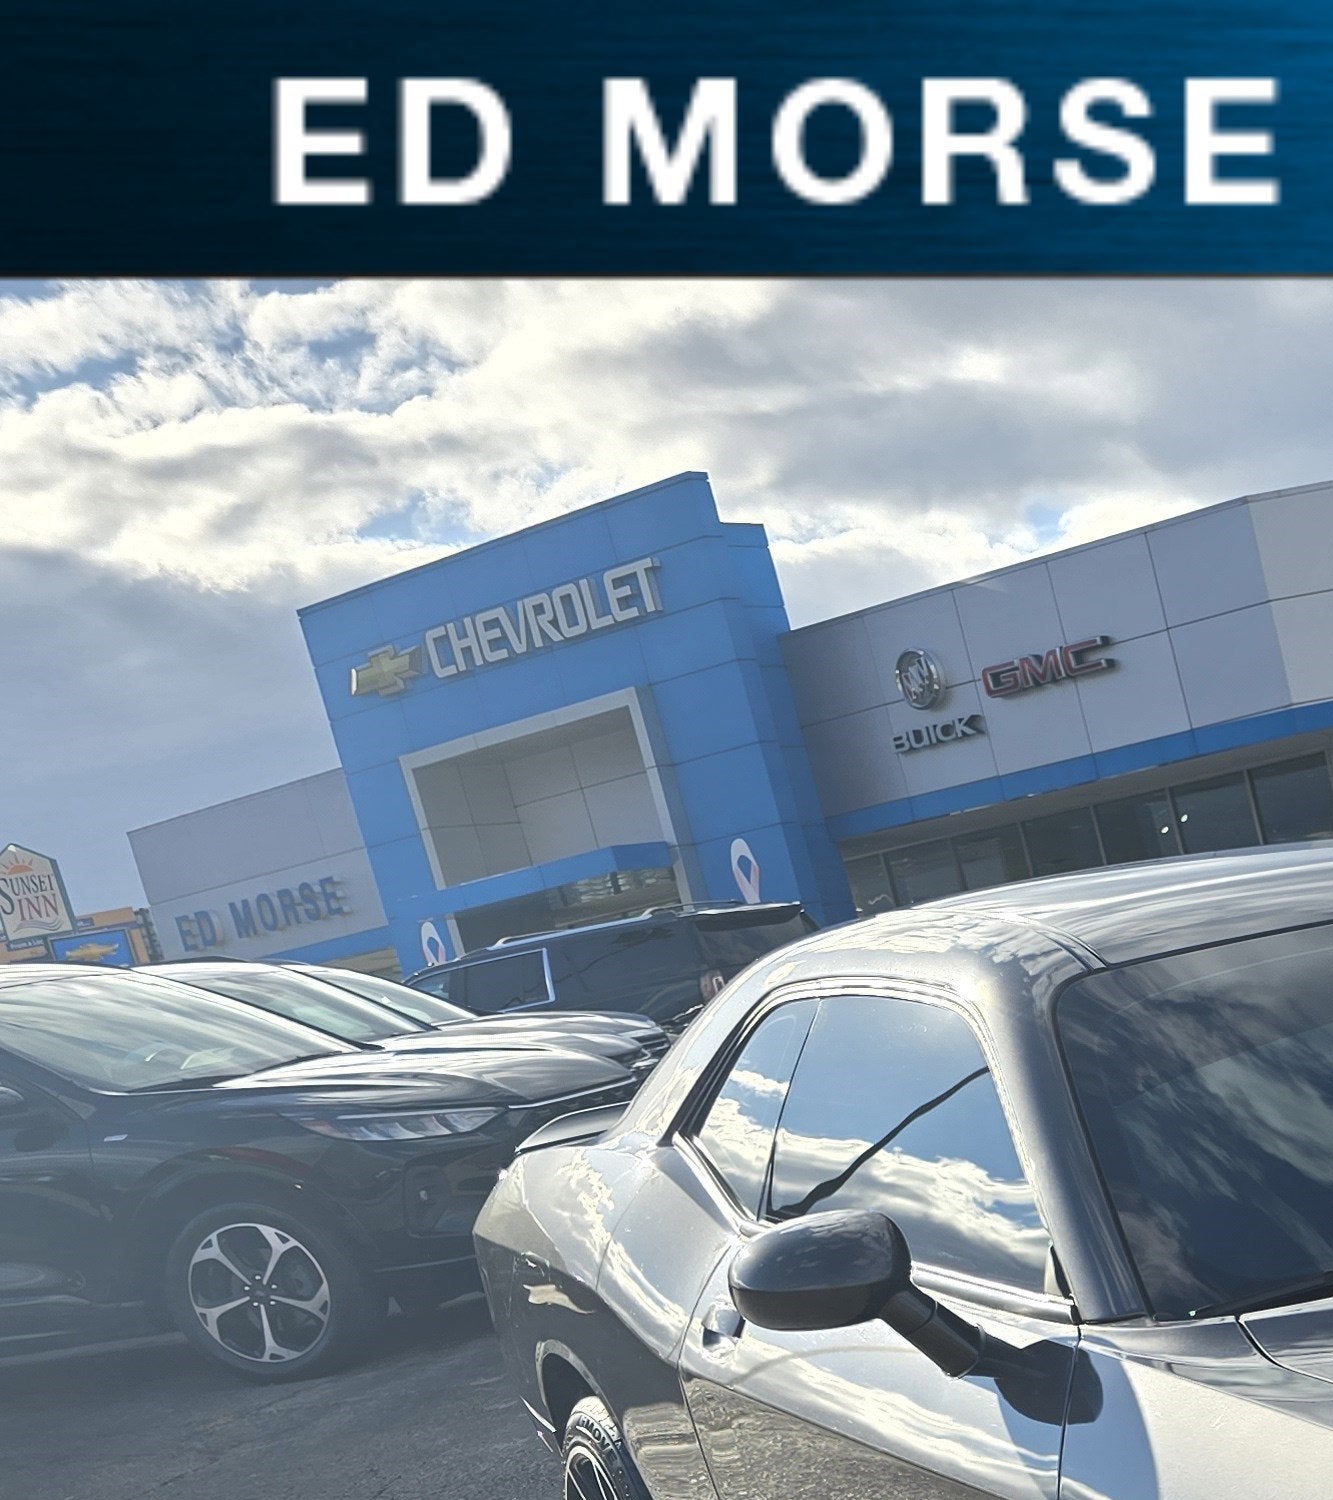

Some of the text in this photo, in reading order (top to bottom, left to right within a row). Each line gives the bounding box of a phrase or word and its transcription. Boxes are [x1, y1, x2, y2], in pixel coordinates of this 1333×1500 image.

[425, 557, 662, 678] CHEVROLET
[981, 635, 1110, 698] GMC
[893, 714, 980, 752] BUICK
[0, 873, 54, 915] SUNSET
[17, 893, 59, 921] INN
[175, 875, 345, 952] ED MORSE
